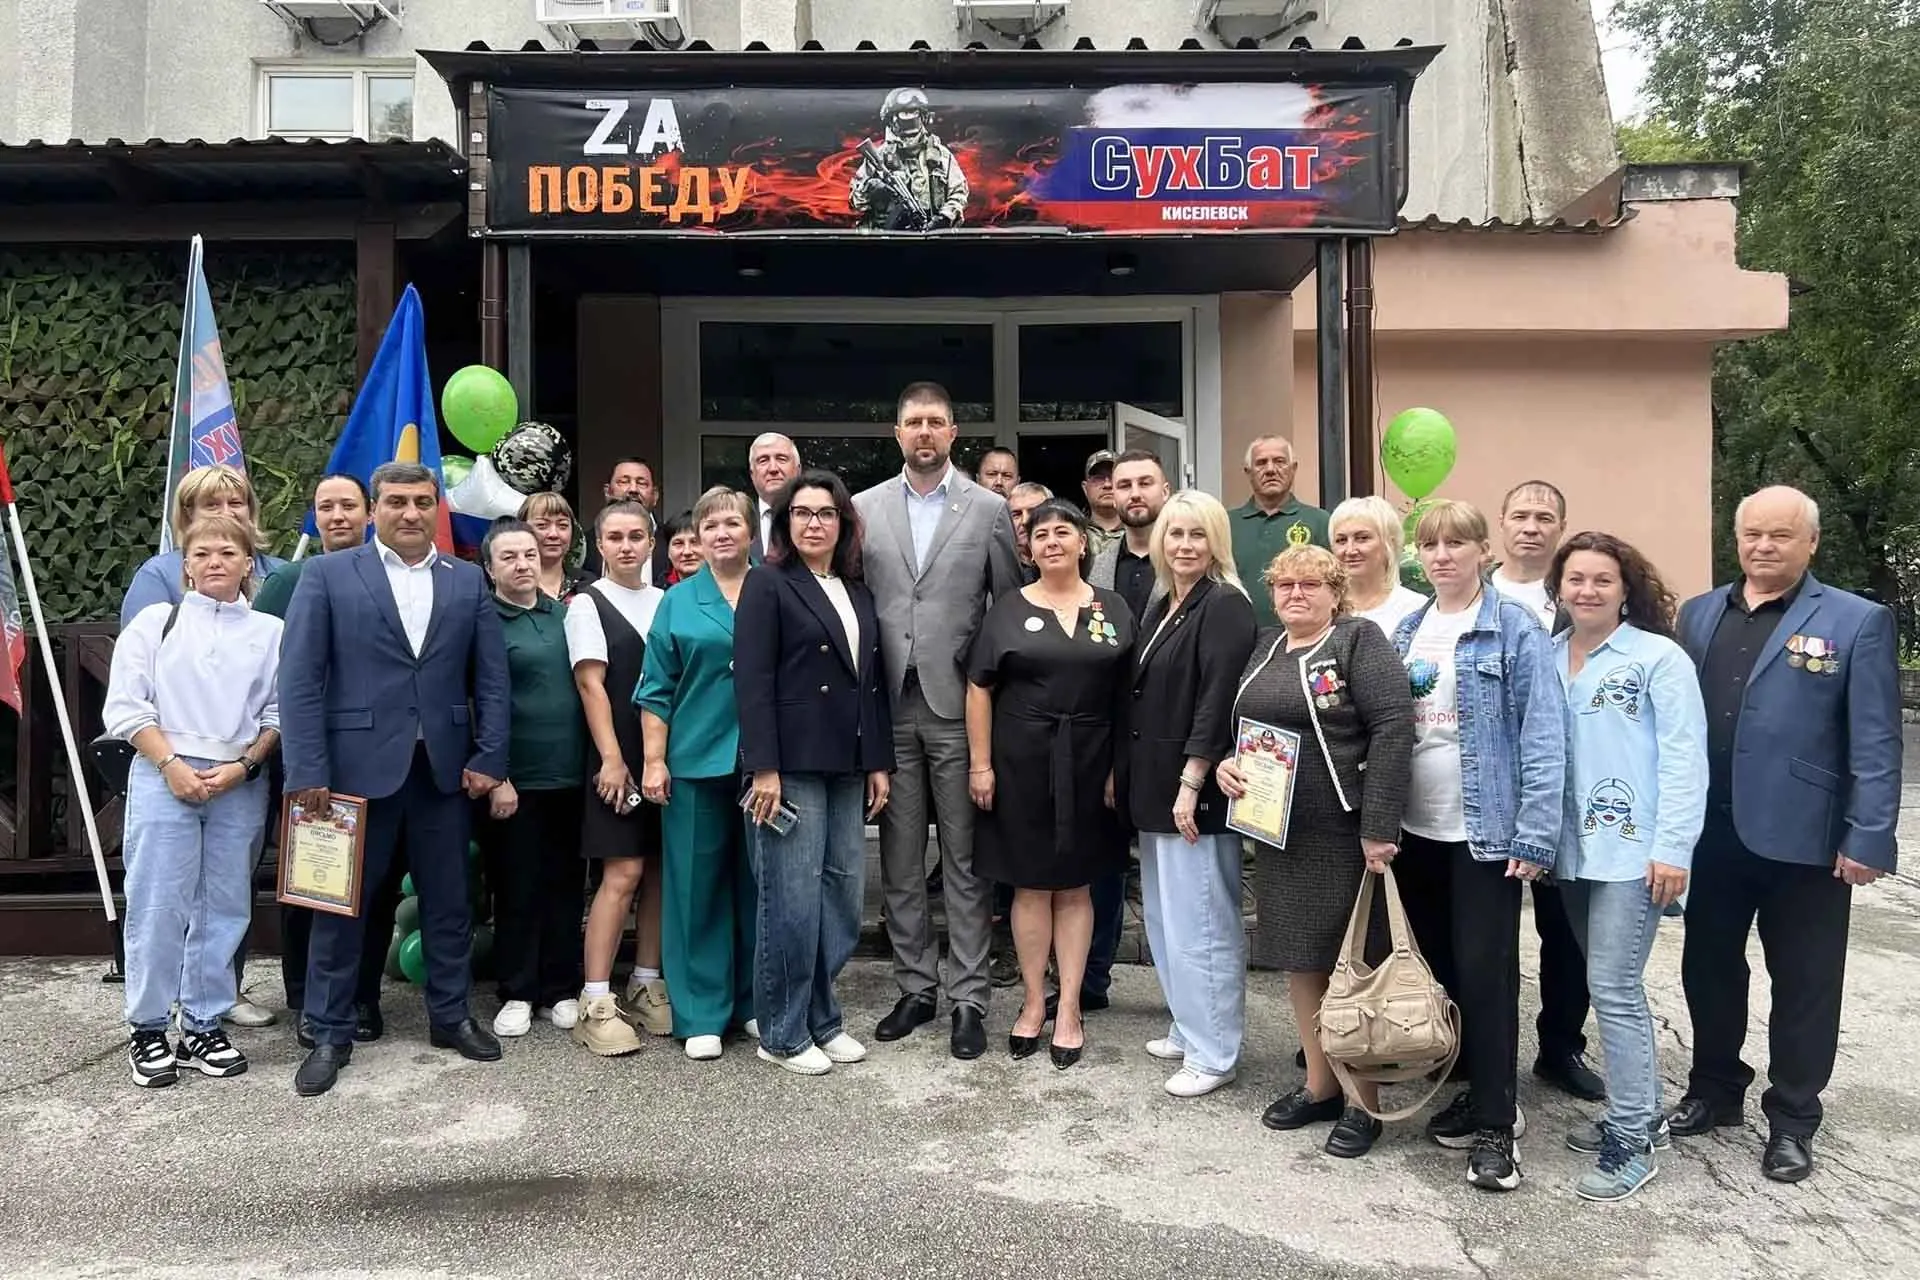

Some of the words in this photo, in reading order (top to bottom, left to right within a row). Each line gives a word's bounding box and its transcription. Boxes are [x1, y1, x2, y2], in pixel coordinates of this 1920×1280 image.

[528, 165, 749, 223] ПОБЕДУ
[1091, 136, 1319, 198] СухБат
[1162, 206, 1248, 221] КИСЕЛЕВСК
